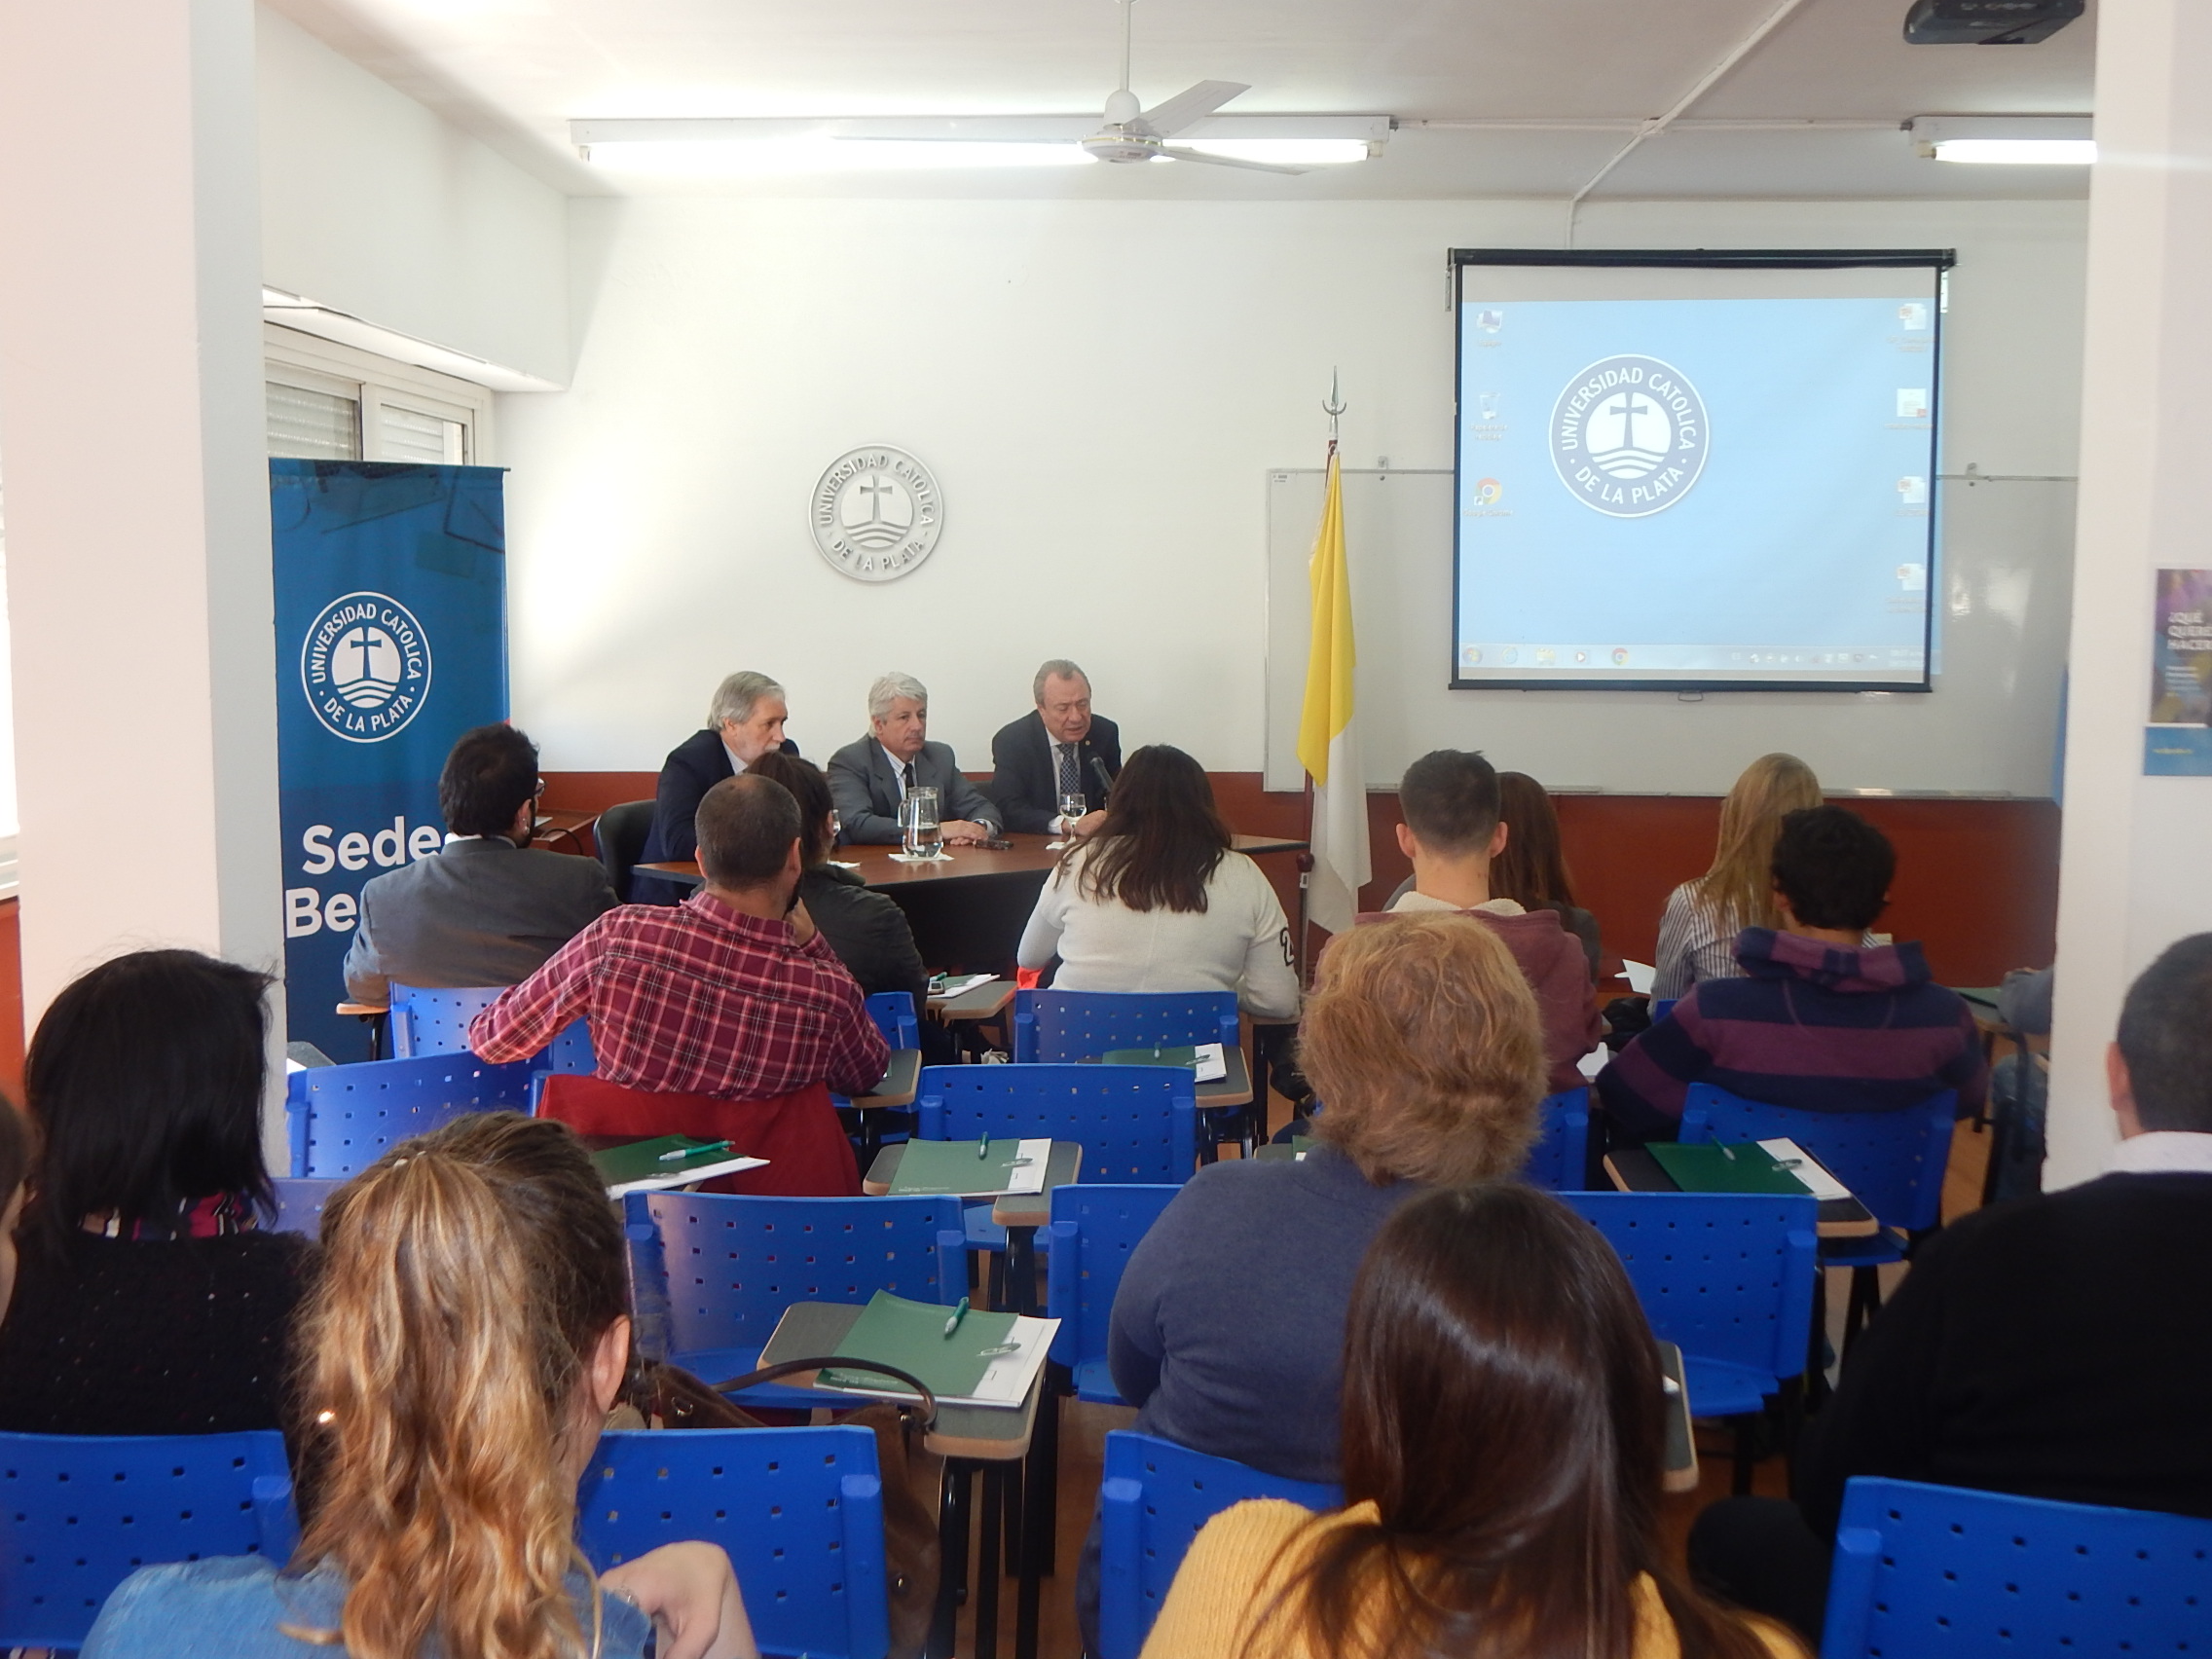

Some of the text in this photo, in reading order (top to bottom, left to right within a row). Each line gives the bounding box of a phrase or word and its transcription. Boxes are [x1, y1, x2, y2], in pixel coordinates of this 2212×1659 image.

[1561, 367, 1697, 451] UNIVERSIDAD CATOLICA
[819, 454, 935, 527] UNIVERSIDAD CATOLICA
[1574, 465, 1684, 504] DE LA PLATA
[831, 538, 924, 571] DE LA PLATA
[312, 603, 423, 684] UNIVERSIDAD CATOLICA
[323, 694, 414, 733] DE LA PLATA
[302, 816, 441, 875] Sede
[285, 887, 357, 939] Be
